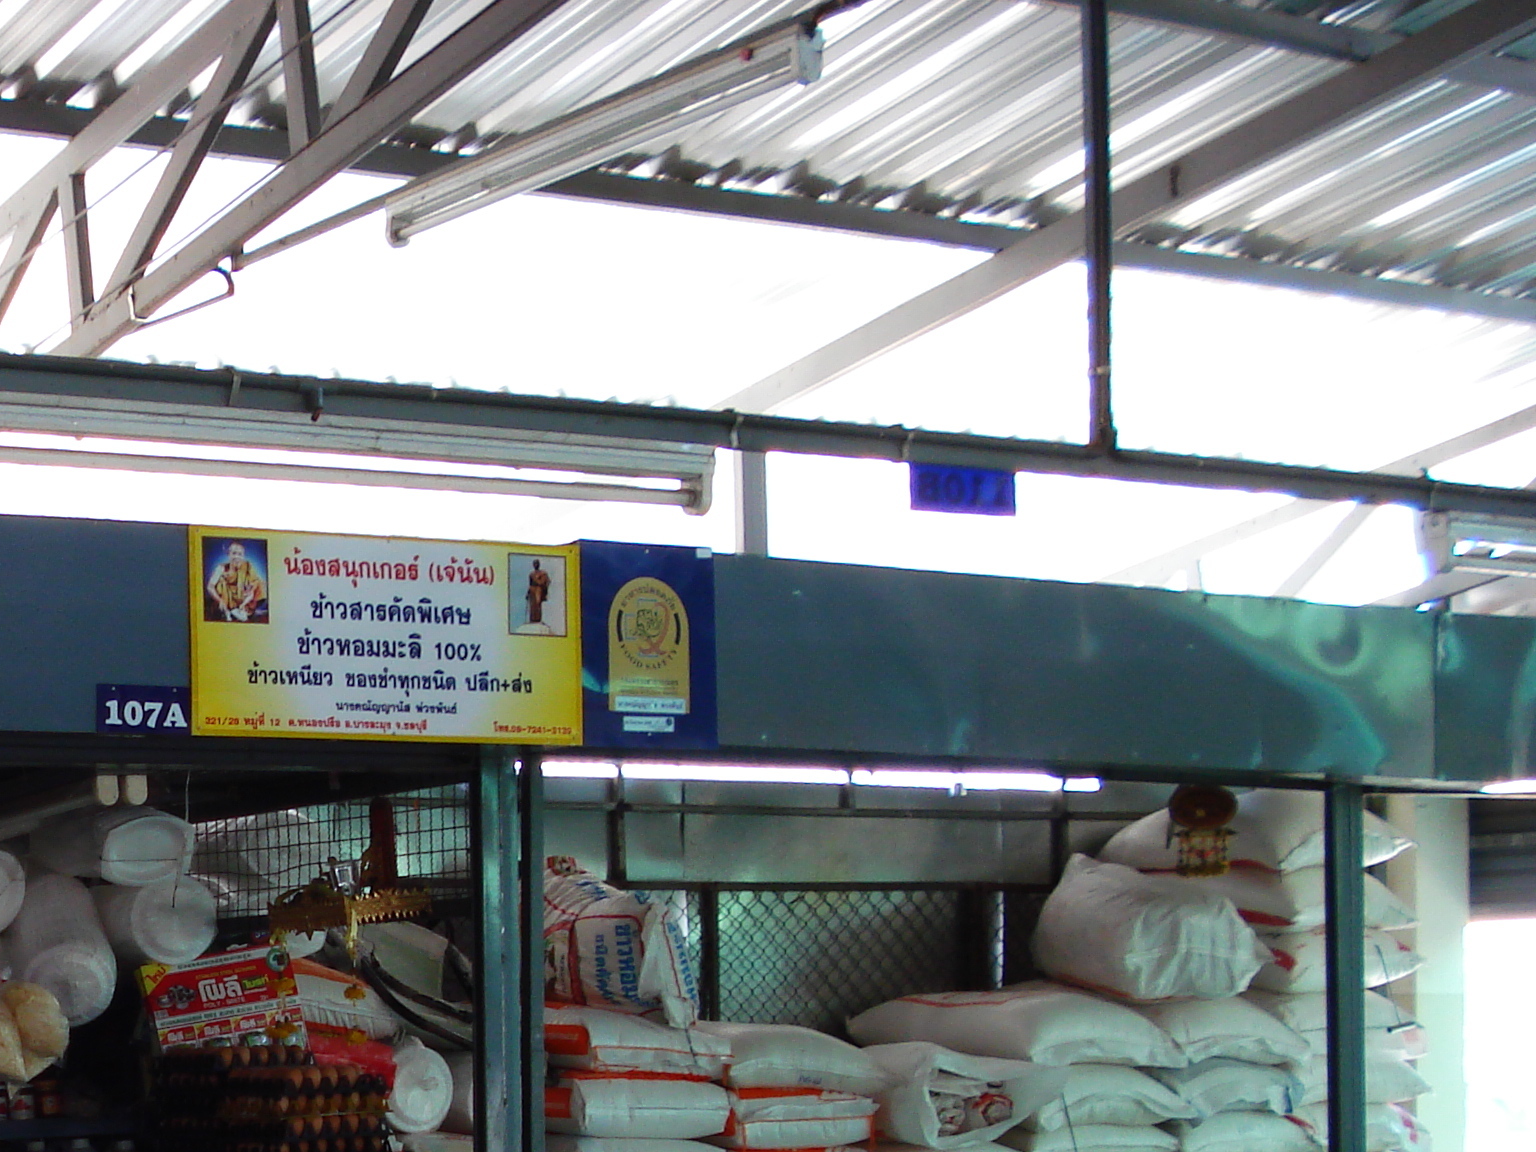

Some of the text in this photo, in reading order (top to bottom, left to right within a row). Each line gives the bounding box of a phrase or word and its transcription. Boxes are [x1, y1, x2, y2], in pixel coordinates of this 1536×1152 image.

[283, 547, 420, 588] น้องสนุกเกอร์
[310, 592, 472, 626] ข้าวสารคัดพิเศษ
[297, 628, 482, 662] ข้าวหอมมะลิ 100%
[247, 661, 533, 698] ข้าวเหนียว ของชำทุกชนิด ปลีก+ส่ง
[105, 699, 188, 728] 107A
[270, 718, 281, 727] 12
[197, 974, 245, 1002] โพลี
